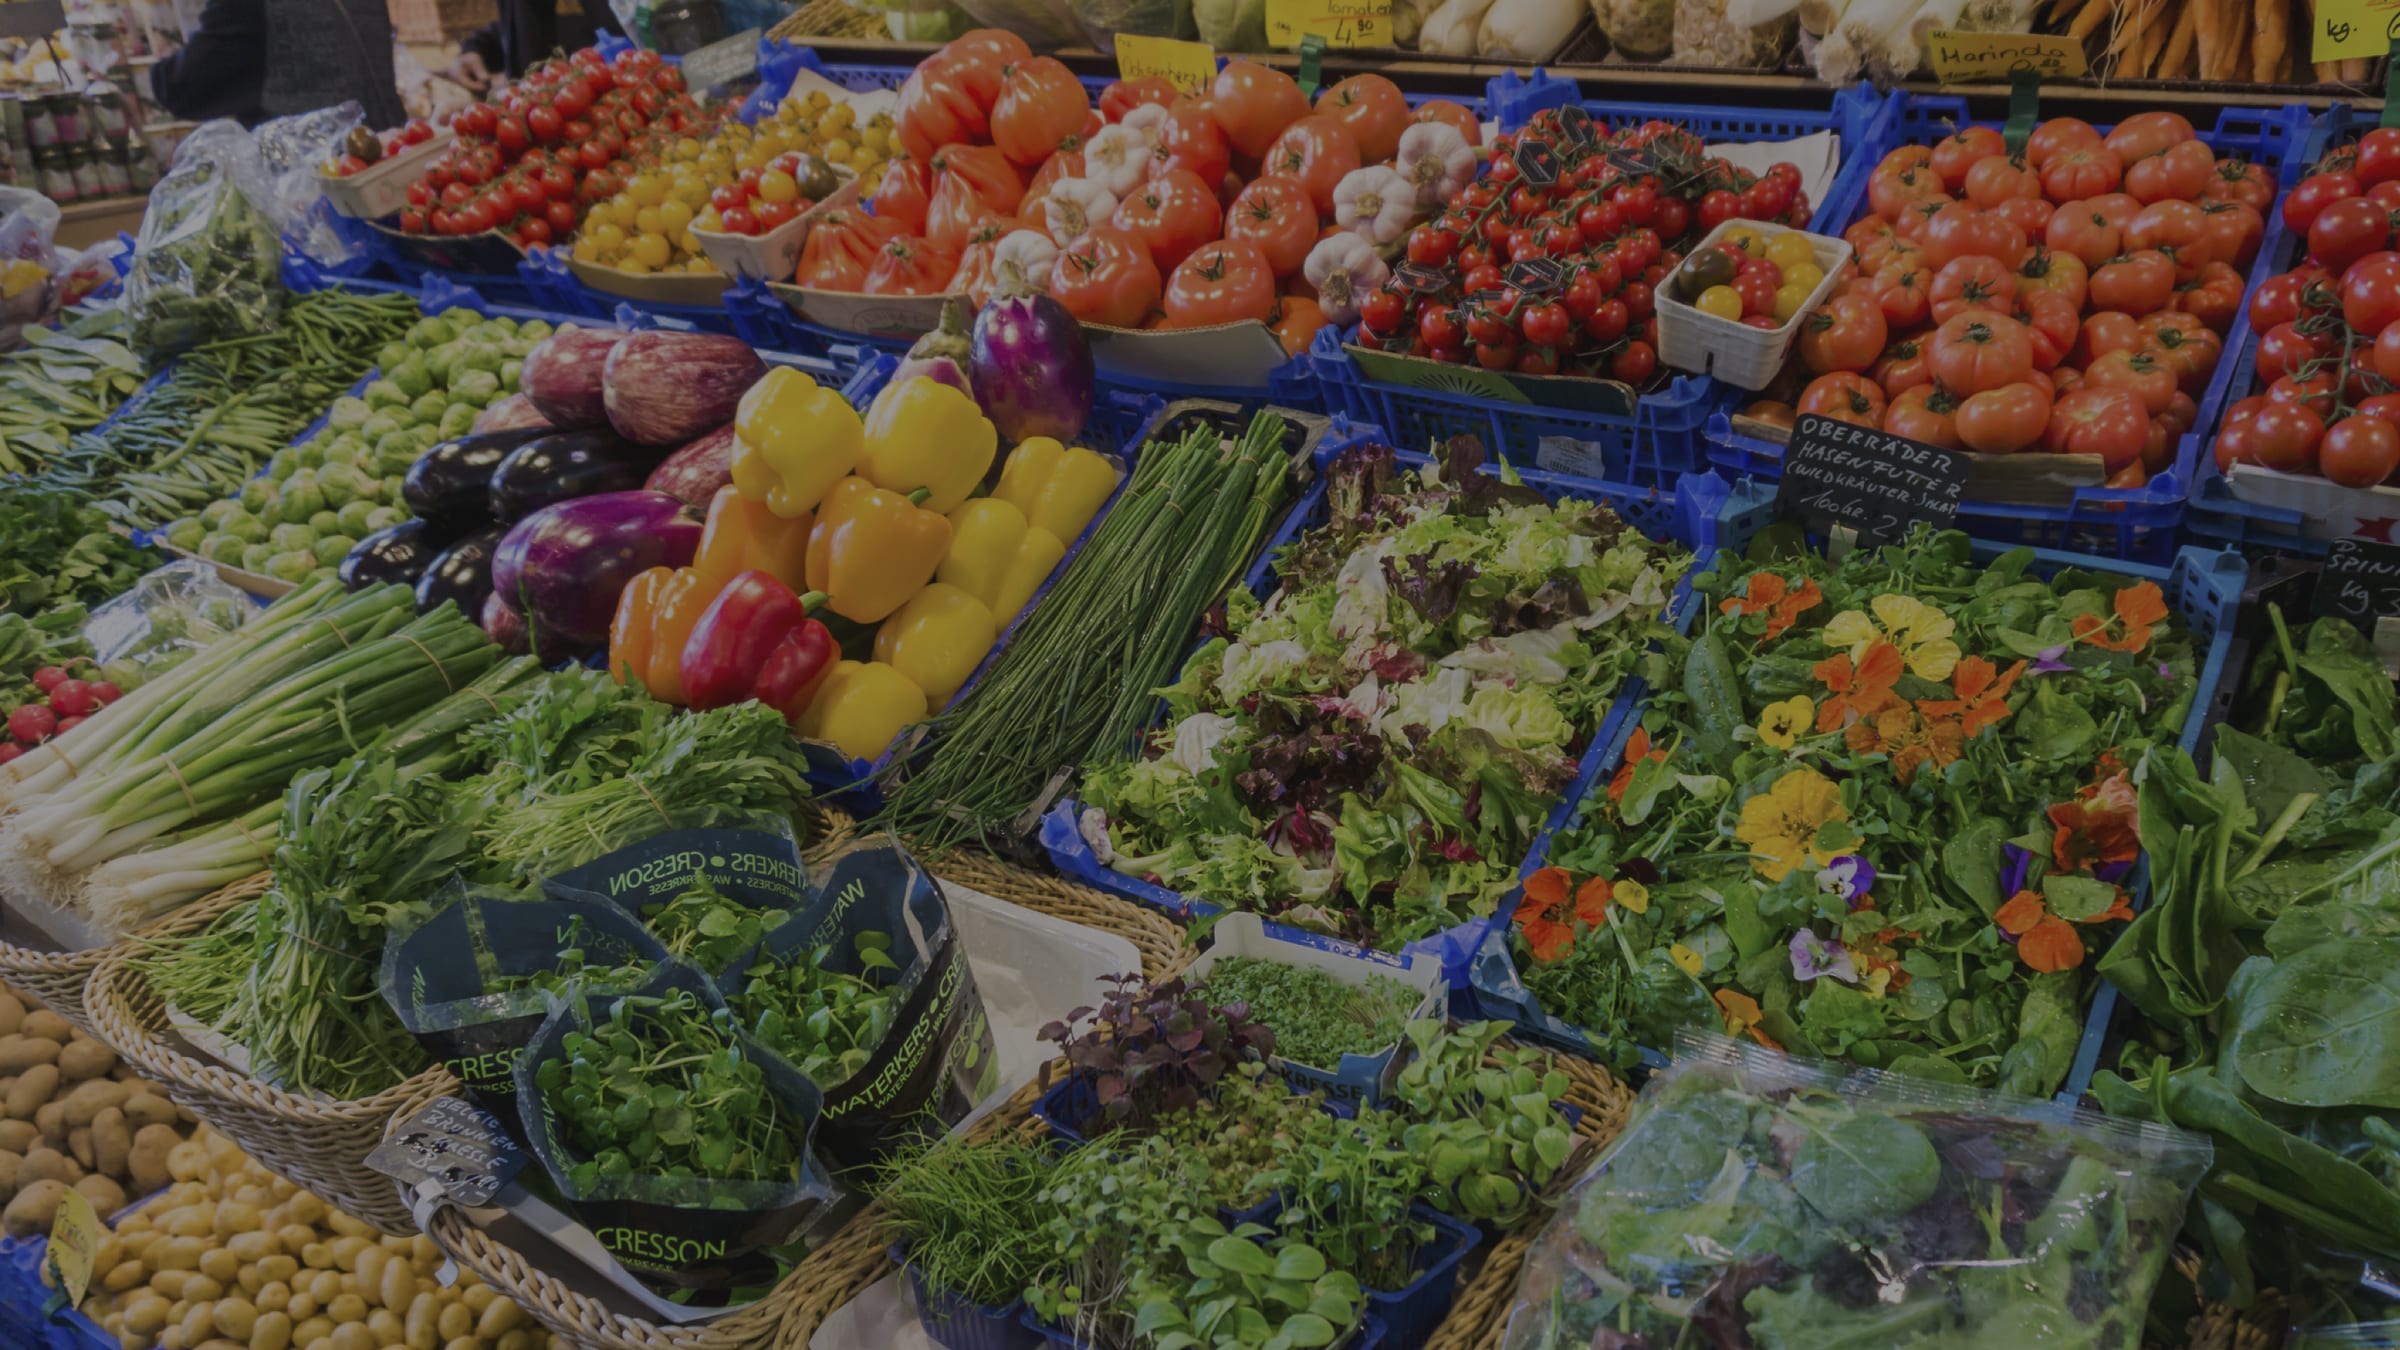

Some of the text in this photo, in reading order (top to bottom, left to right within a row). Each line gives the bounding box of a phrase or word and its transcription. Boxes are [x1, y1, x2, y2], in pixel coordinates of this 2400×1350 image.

[1802, 418, 1952, 474] OBERRÄDER
[821, 1011, 931, 1121] WATERKERS
[1281, 1066, 1363, 1098] KRESSE
[595, 1227, 726, 1263] CRESSON
